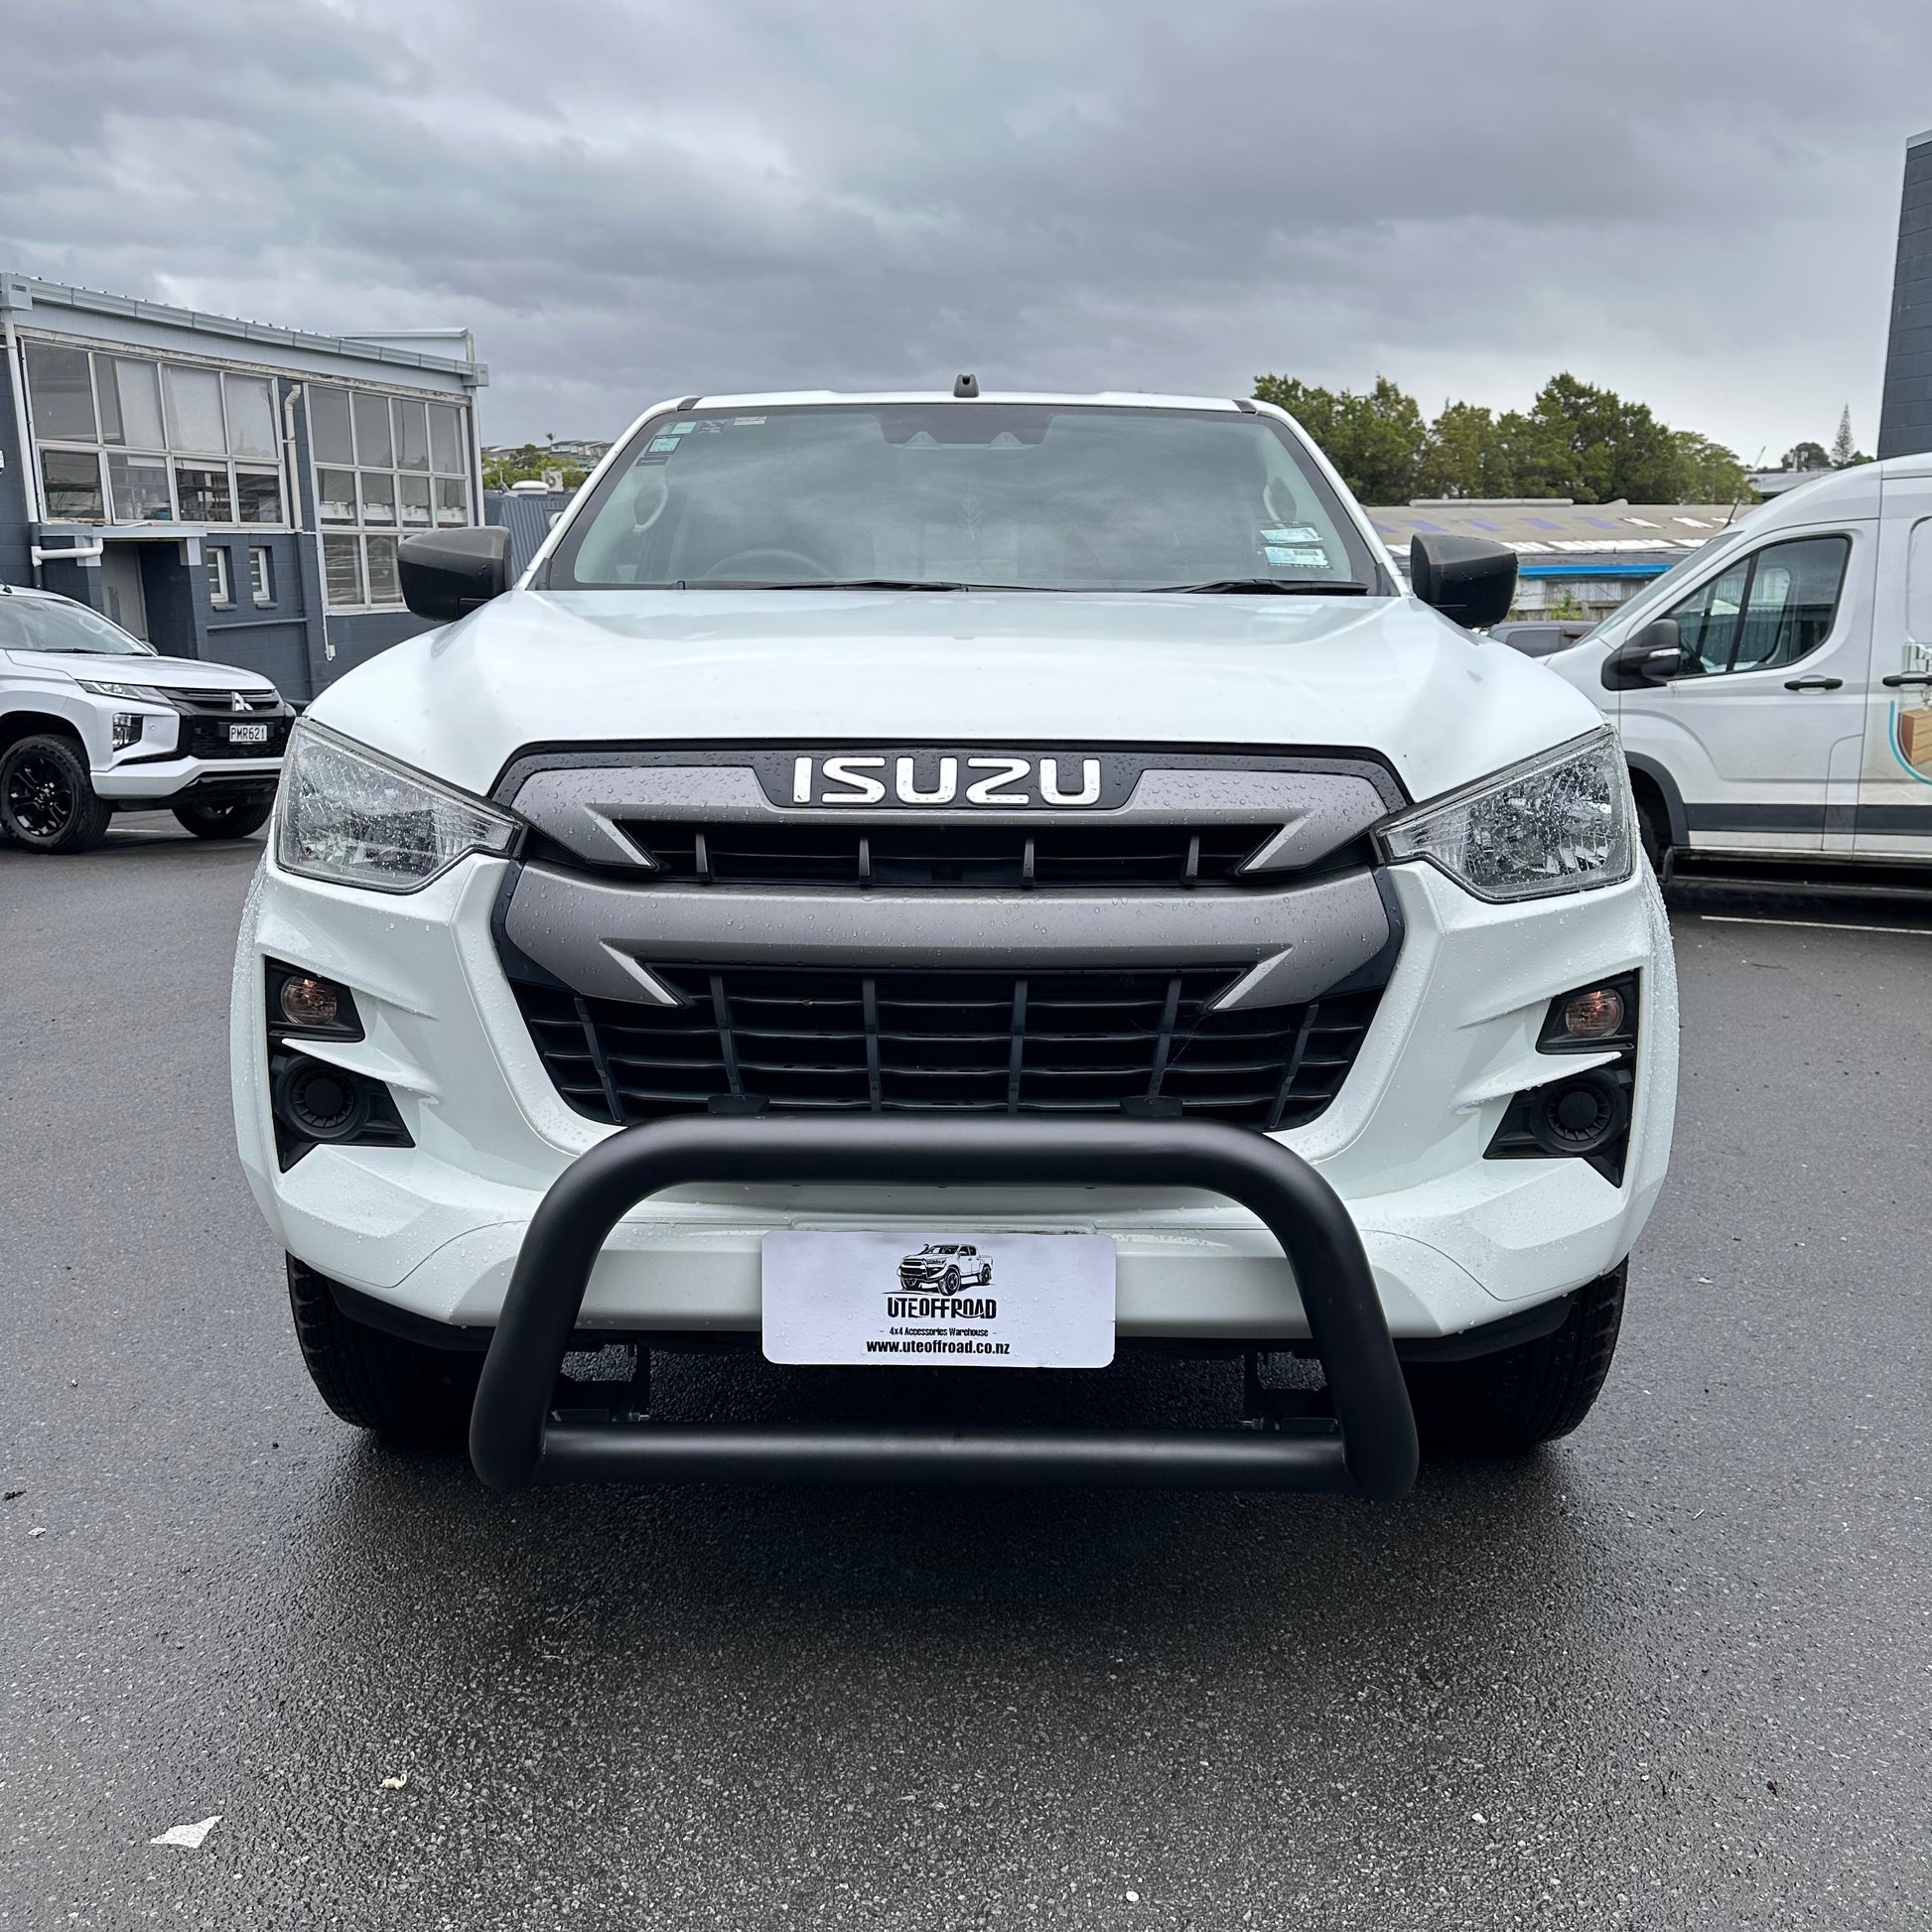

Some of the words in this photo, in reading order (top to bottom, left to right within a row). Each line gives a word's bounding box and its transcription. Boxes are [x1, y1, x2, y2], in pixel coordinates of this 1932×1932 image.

[230, 727, 265, 740] PMR621
[793, 757, 1101, 805] ISUZU
[887, 1297, 997, 1318] UTEOFFROAD
[889, 1326, 903, 1336] 4x4
[904, 1326, 948, 1336] Accessories
[949, 1327, 989, 1337] Warehouse
[866, 1339, 1011, 1354] www.uteoffroad.co.nz
